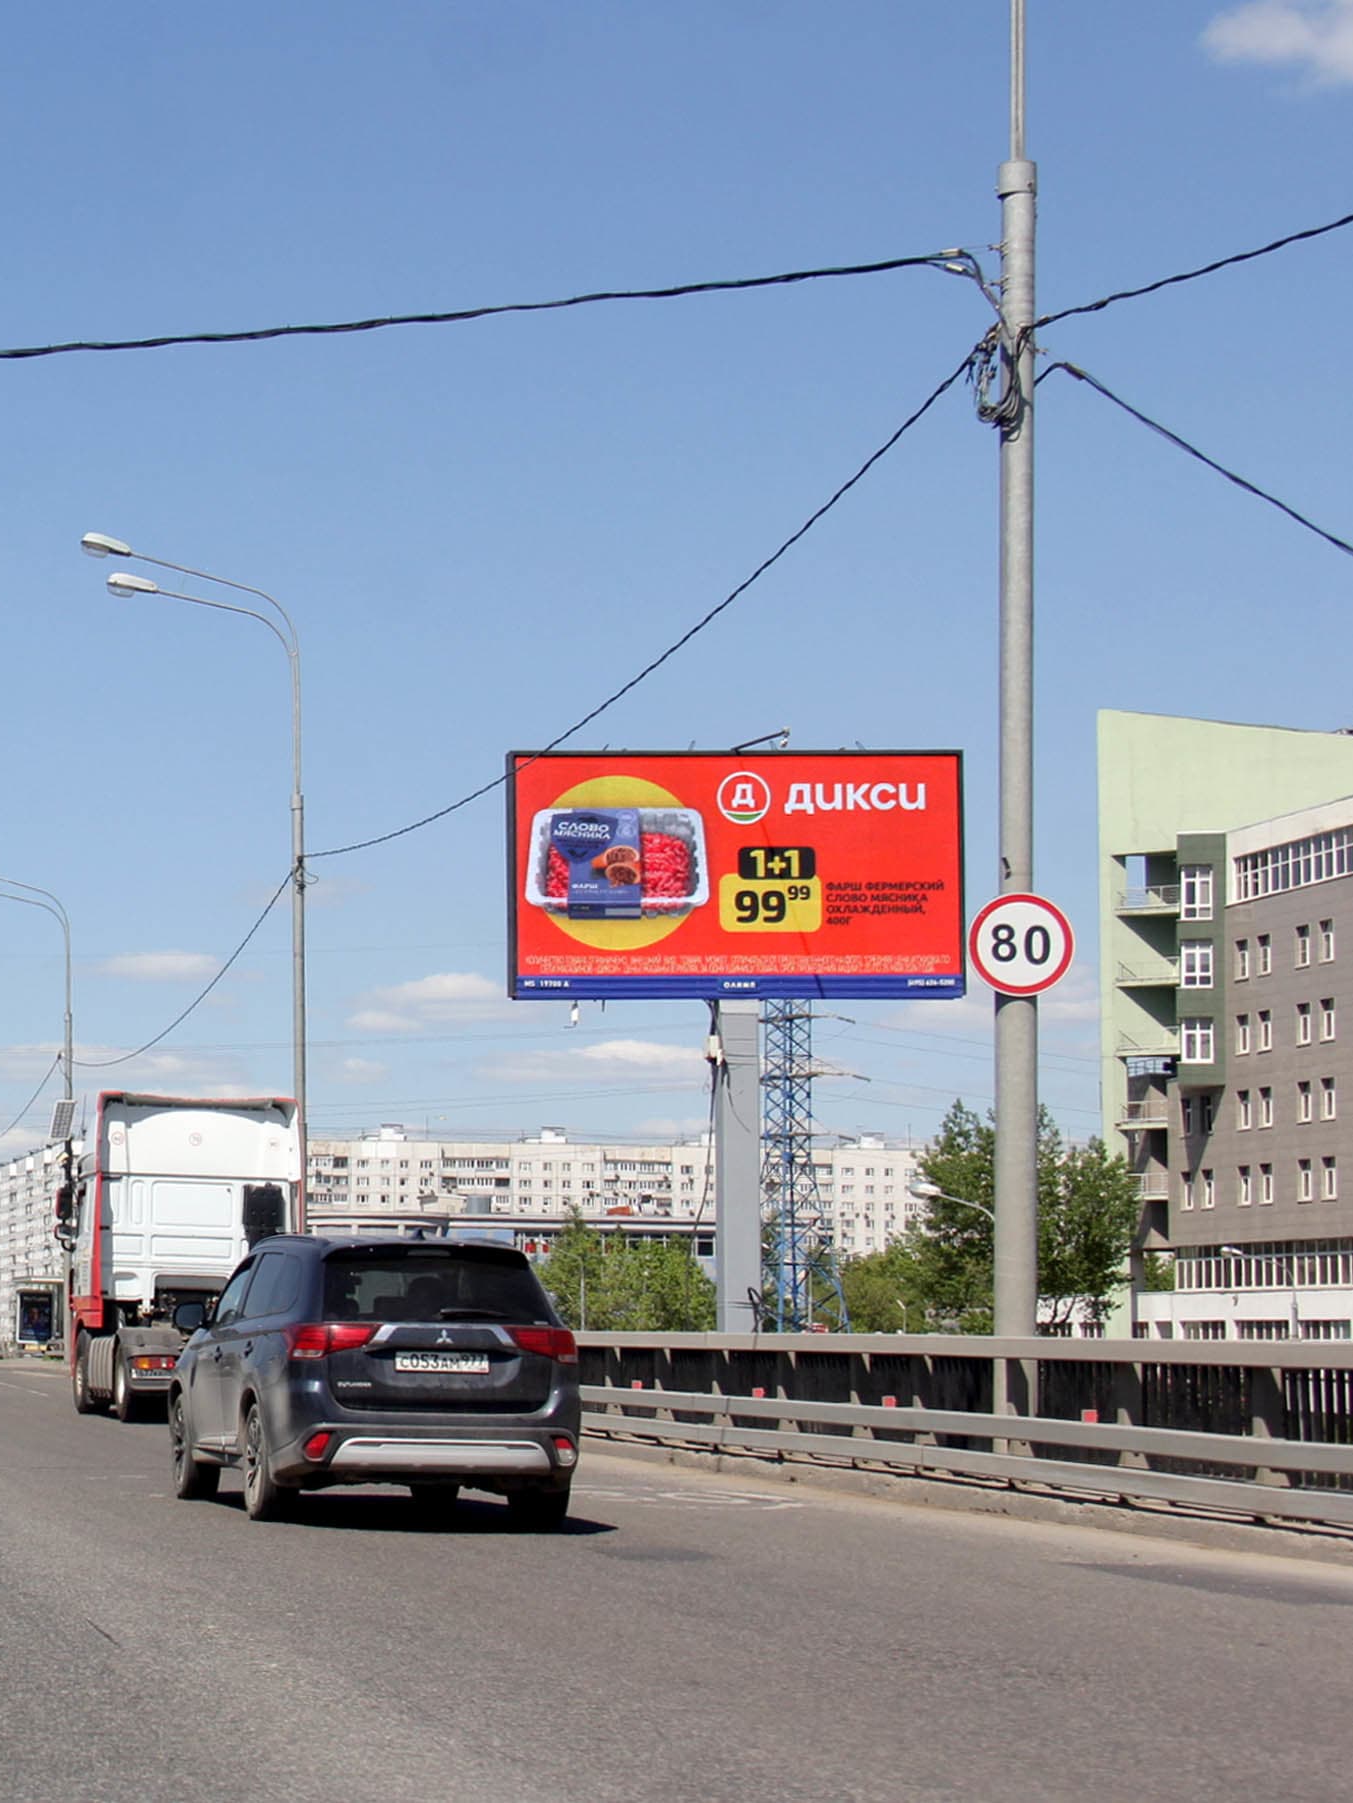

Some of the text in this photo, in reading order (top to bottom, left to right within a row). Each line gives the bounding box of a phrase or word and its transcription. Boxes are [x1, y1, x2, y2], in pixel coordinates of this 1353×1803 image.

[750, 850, 800, 878] 1+1
[826, 882, 862, 891] ФАРШ
[826, 893, 868, 903] СЛОВО
[735, 886, 811, 923] 99 99
[991, 923, 1051, 965] 80
